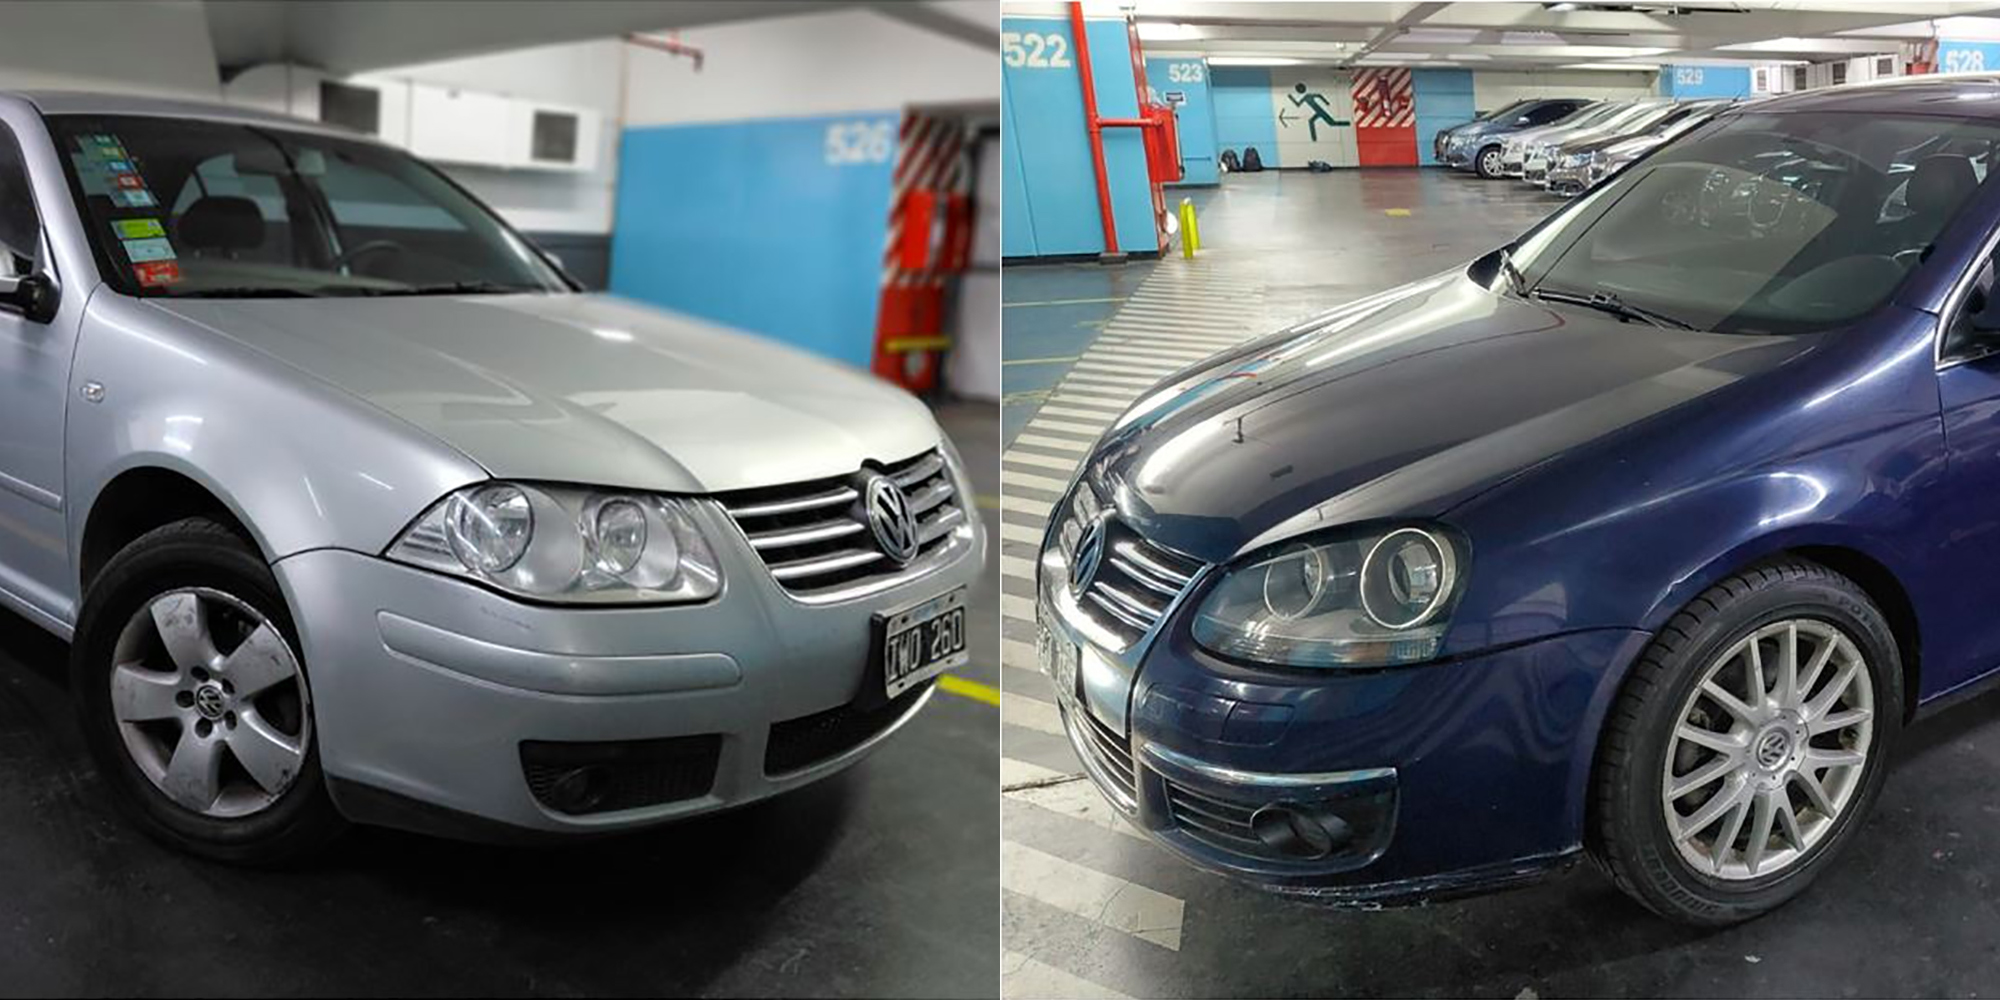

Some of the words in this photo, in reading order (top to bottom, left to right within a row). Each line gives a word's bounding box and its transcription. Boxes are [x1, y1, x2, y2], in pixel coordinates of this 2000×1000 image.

[1002, 32, 1071, 68] 522
[1946, 49, 1985, 75] 528
[1168, 63, 1203, 83] 523
[1677, 67, 1704, 86] 529
[823, 120, 893, 165] 526
[930, 608, 963, 661] 260
